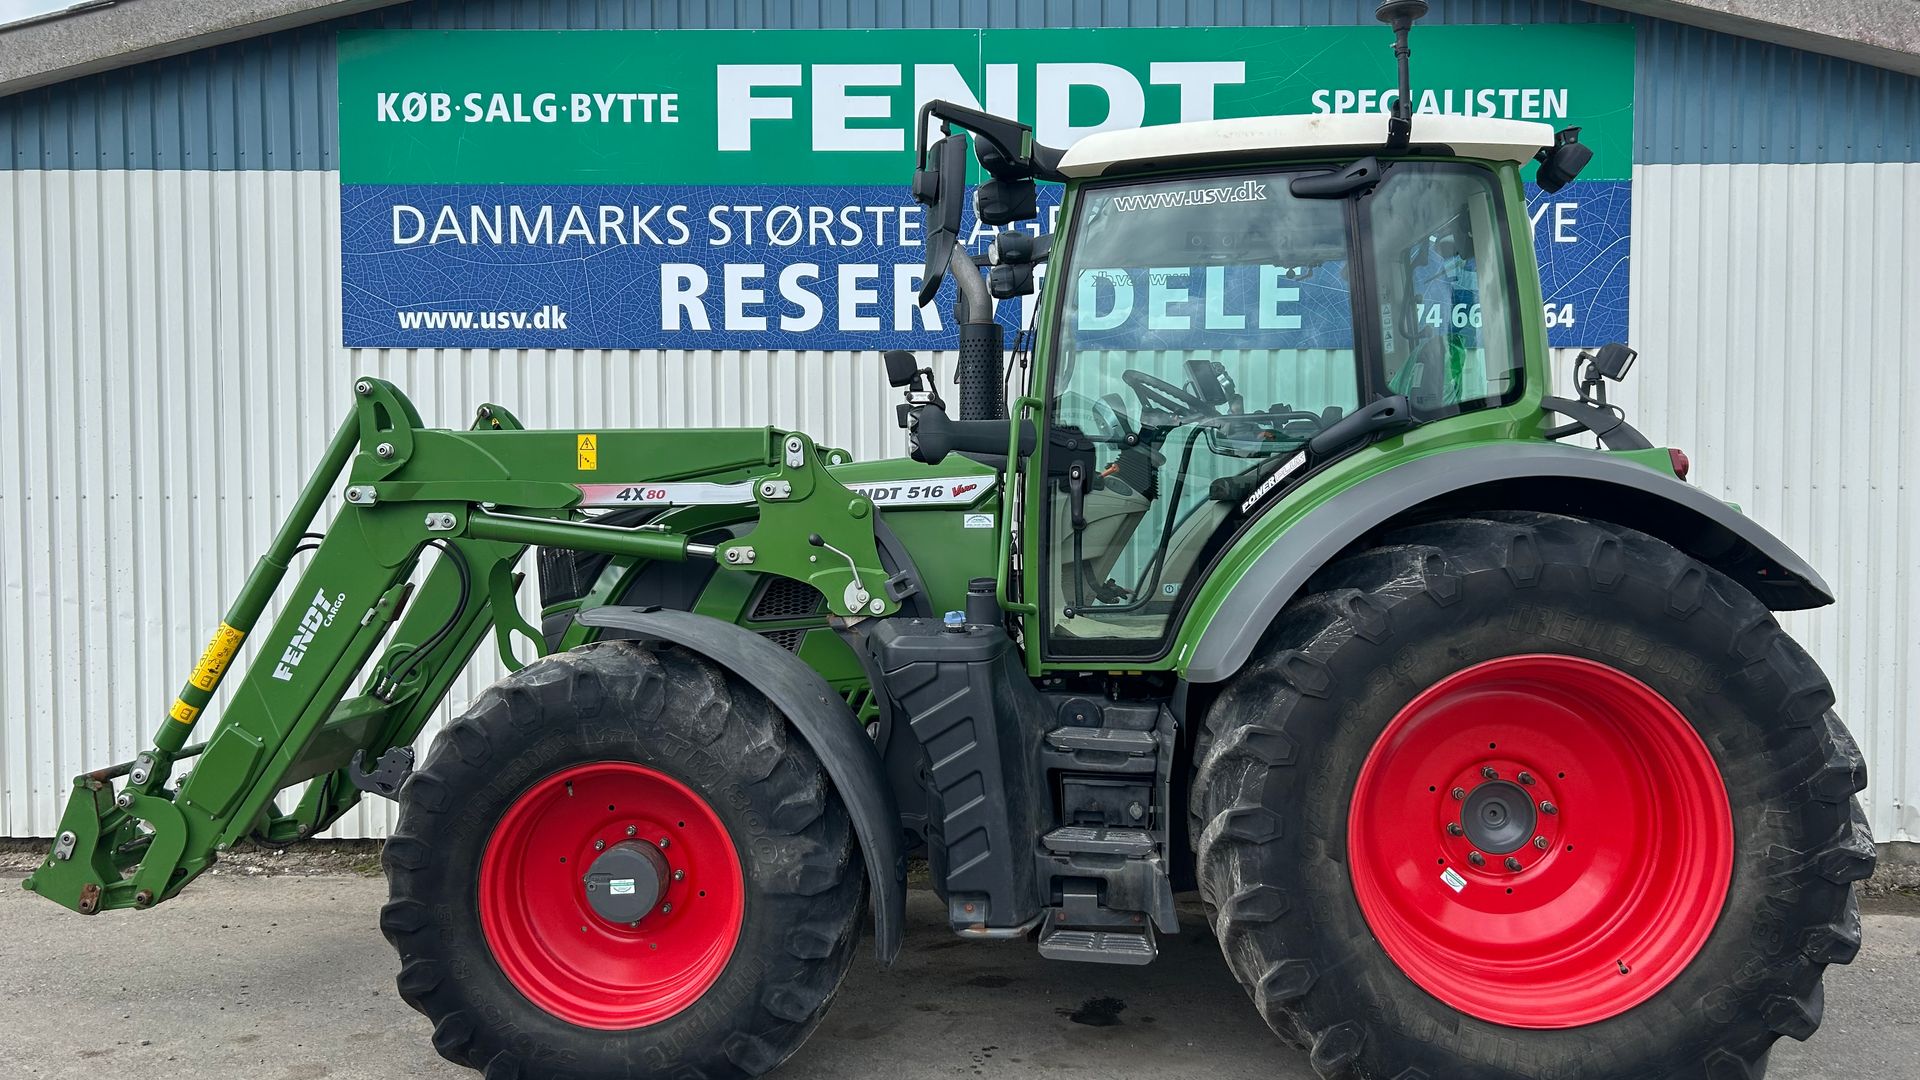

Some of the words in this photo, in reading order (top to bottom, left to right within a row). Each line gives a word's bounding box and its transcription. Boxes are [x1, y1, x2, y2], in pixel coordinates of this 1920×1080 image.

[717, 61, 1245, 151] FENDT
[1311, 88, 1568, 119] SPECALISTEN
[1114, 180, 1267, 212] www.usv.dk
[392, 205, 690, 246] DANMARKS
[707, 204, 922, 248] STØRSTE
[1527, 202, 1578, 243] YE
[660, 263, 1302, 332] RESERDELE
[1544, 303, 1575, 328] 64
[398, 305, 567, 331] www.usv.dk
[850, 487, 902, 501] NDT
[907, 485, 944, 499] 516
[323, 592, 346, 628] CARGO
[272, 587, 331, 682] FENDT
[1507, 601, 1725, 694] TRELLEBORG
